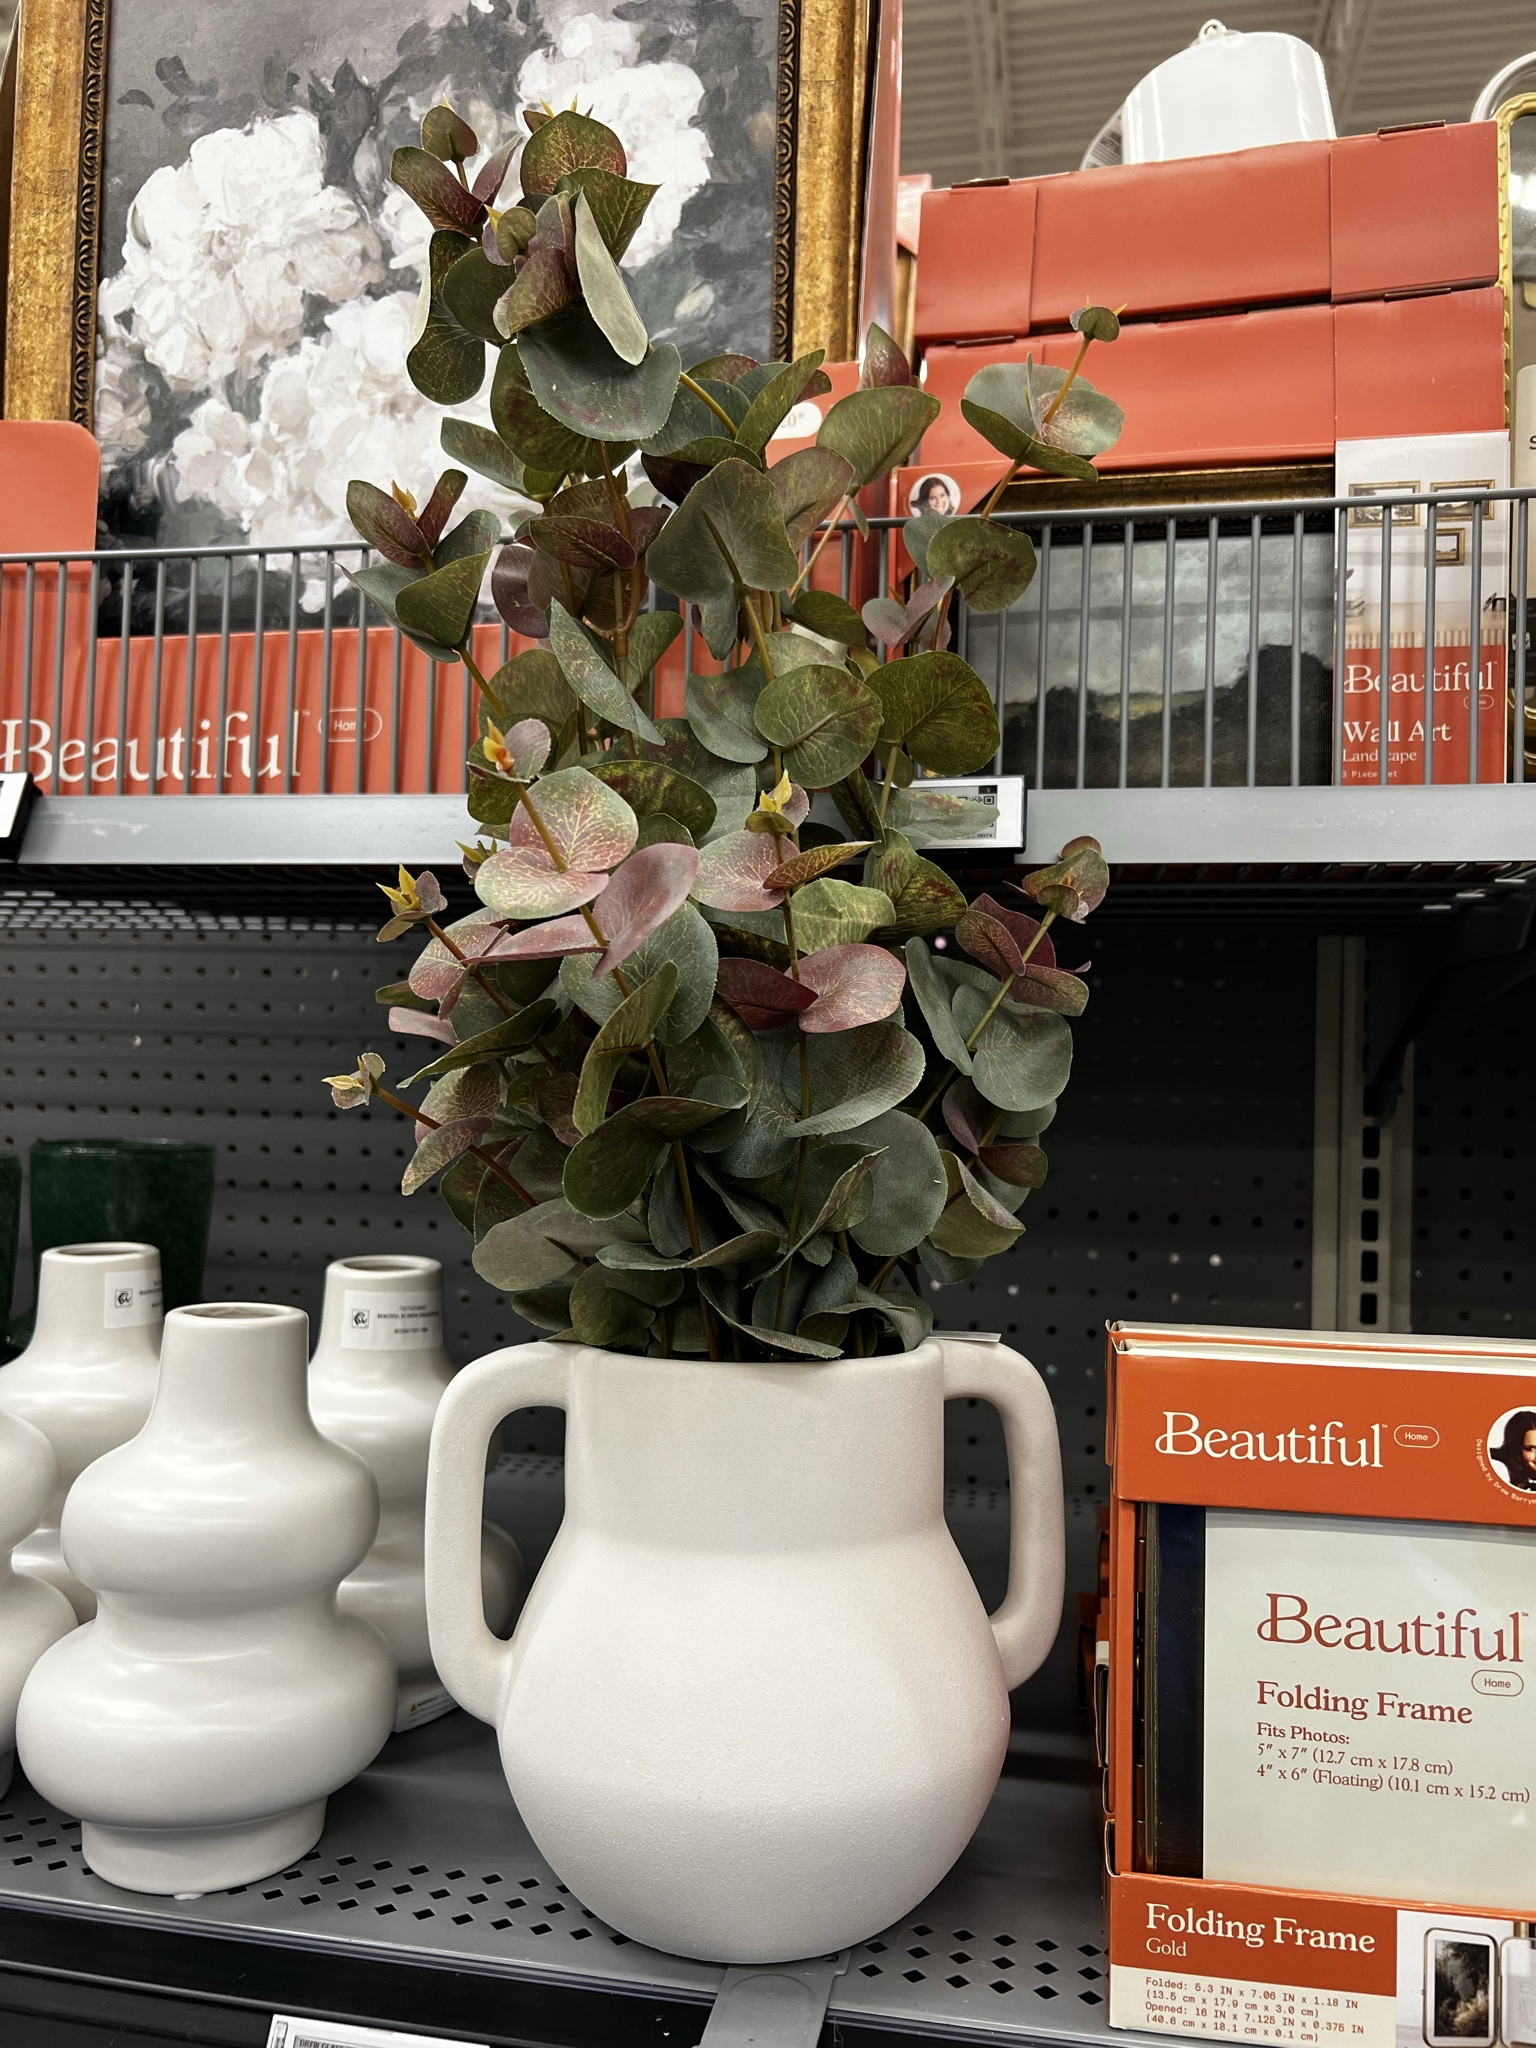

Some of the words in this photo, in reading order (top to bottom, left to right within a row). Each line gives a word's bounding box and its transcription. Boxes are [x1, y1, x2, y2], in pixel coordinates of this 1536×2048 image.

[1343, 720, 1401, 744] Wall
[1408, 719, 1452, 742] Art
[1342, 748, 1418, 764] Landcape
[1352, 770, 1378, 779] Piece
[1404, 1431, 1429, 1442] Home
[1475, 1438, 1488, 1472] Designed
[1485, 1472, 1494, 1482] by
[1493, 1481, 1510, 1496] Drew
[1484, 1677, 1511, 1689] Home
[1257, 1680, 1369, 1721] Folding
[1376, 1691, 1473, 1724] Frame
[1257, 1721, 1286, 1739] Fits
[1290, 1725, 1350, 1745] Photos:
[1278, 1748, 1288, 1759] x
[1312, 1747, 1346, 1765] (12.7
[1350, 1755, 1374, 1768] cm
[1378, 1758, 1387, 1769] x
[1393, 1756, 1420, 1772] 17.8
[1424, 1760, 1453, 1776] cm)
[1278, 1769, 1288, 1780] x
[1312, 1768, 1384, 1792] (Floating)
[1388, 1777, 1420, 1794] (10.1
[1426, 1783, 1450, 1796] cm
[1454, 1787, 1464, 1797] x
[1469, 1785, 1497, 1800] 15.2
[1501, 1787, 1530, 1804] cm)
[1145, 1902, 1266, 1946] Folding
[1273, 1916, 1376, 1953] Frame
[1145, 1937, 1188, 1957] Gold
[1146, 1977, 1188, 1990] Folded:
[1220, 1985, 1233, 1996] IN
[1251, 1989, 1276, 2000] 7.06
[1283, 1992, 1295, 2002] IN
[1314, 1996, 1339, 2007] 1.18
[1346, 1999, 1358, 2009] IN
[1147, 1990, 1177, 2001] (13.5
[1182, 1995, 1196, 2003] cm
[1201, 1997, 1207, 2005] x
[1214, 1997, 1239, 2008] 17.9
[1244, 2002, 1257, 2010] cm
[1275, 2004, 1295, 2014] 3.0
[1301, 2008, 1319, 2018] cm)
[1145, 2001, 1188, 2014] Opened:
[1195, 2007, 1208, 2017] 16
[1213, 2010, 1226, 2019] IN
[1245, 2013, 1276, 2025] 7.125
[1282, 2017, 1295, 2027] IN
[1313, 2020, 1345, 2032] 0.375
[1352, 2024, 1364, 2034] IN
[1146, 2014, 1177, 2025] (40.6
[1182, 2020, 1195, 2028] cm
[1213, 2022, 1238, 2032] 18.1
[1244, 2027, 1257, 2035] cm
[1275, 2028, 1294, 2039] 0.1
[1300, 2033, 1318, 2043] cm)
